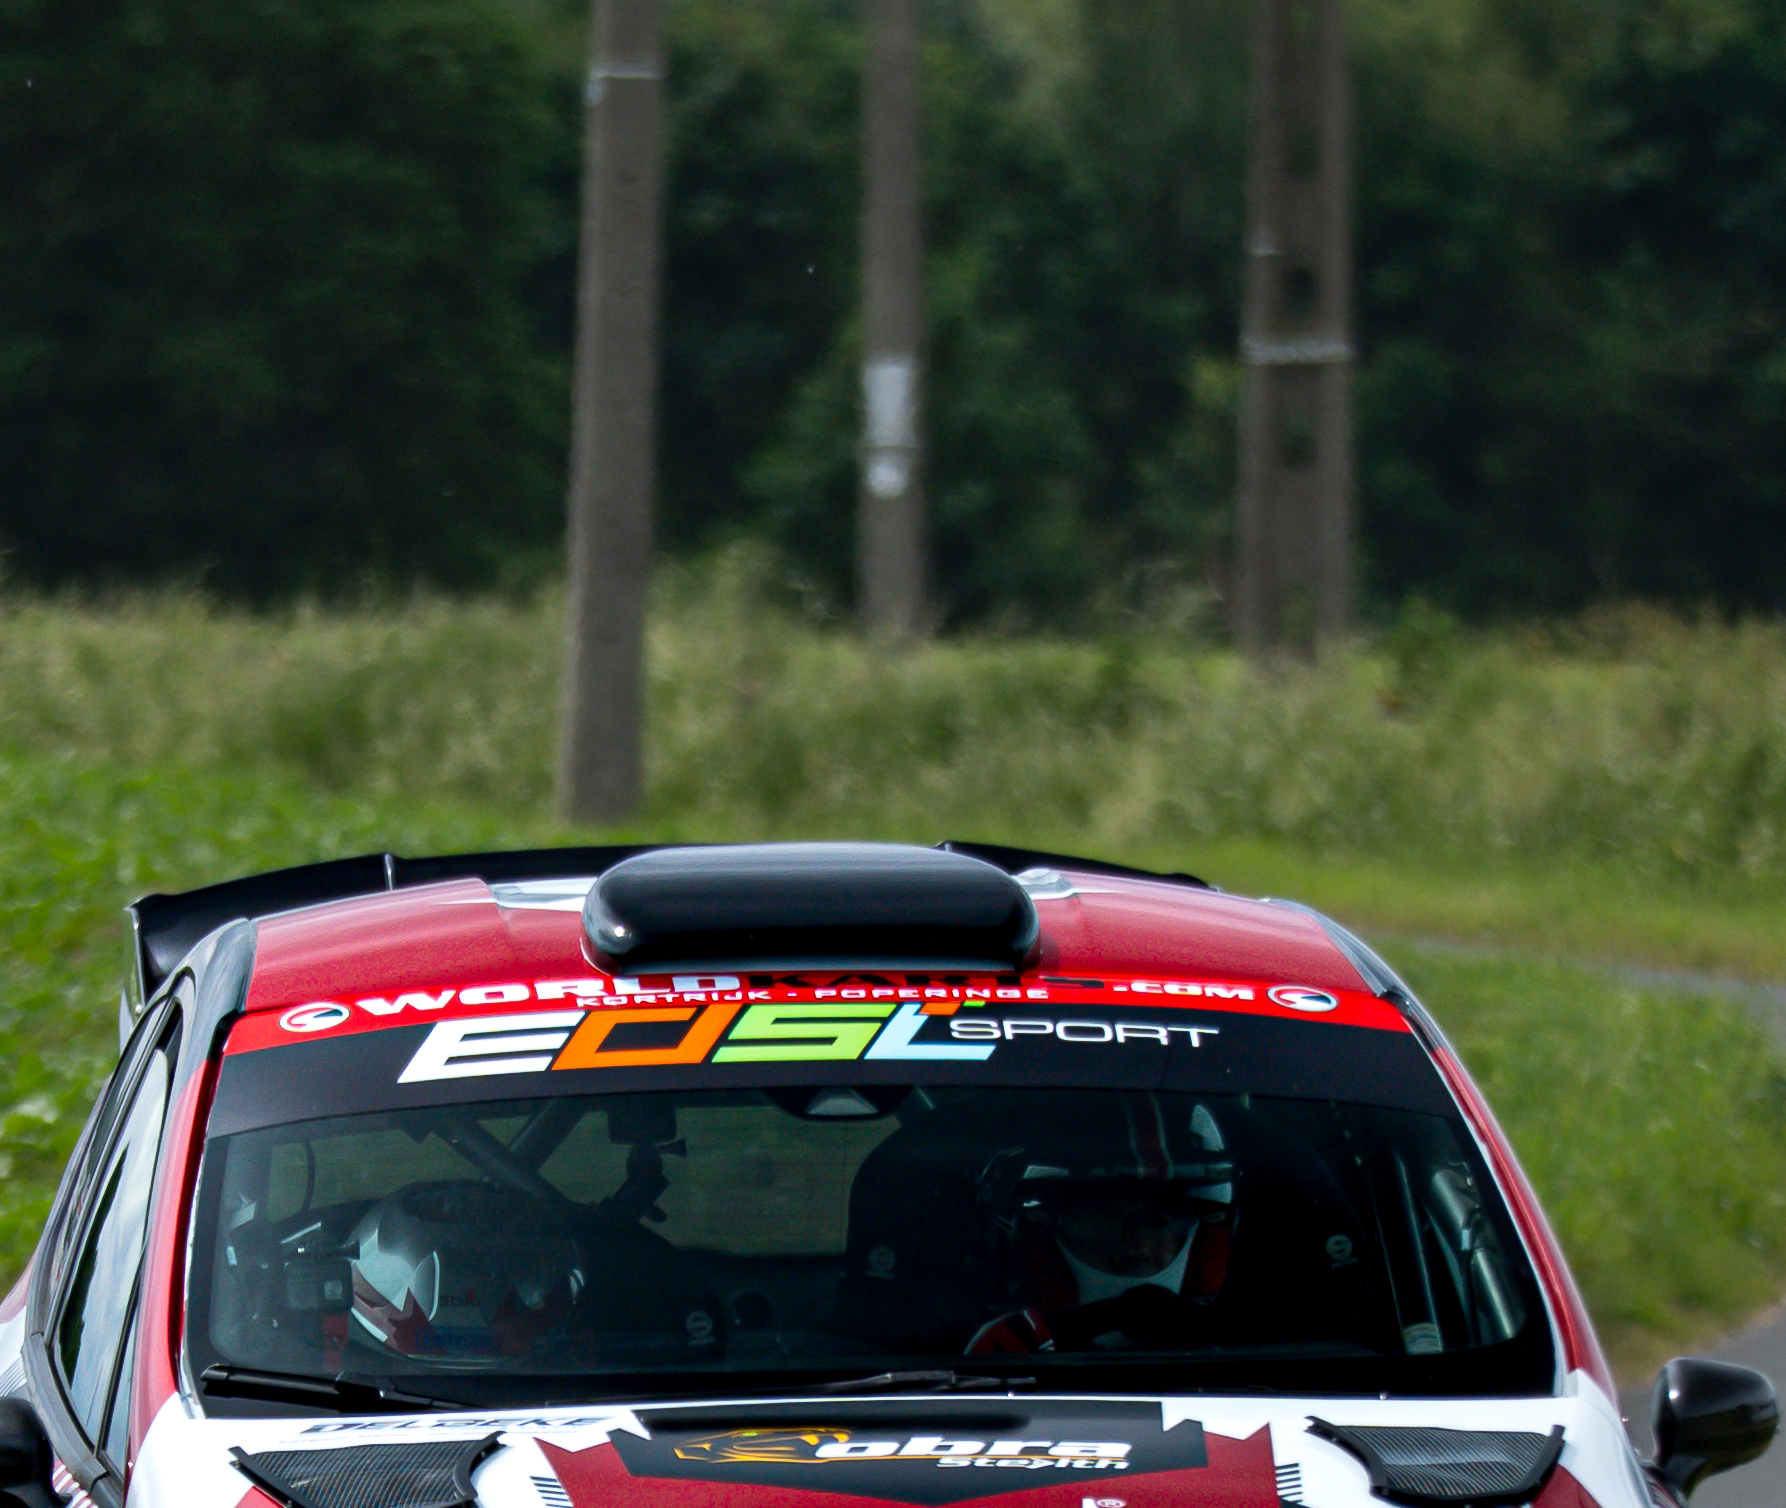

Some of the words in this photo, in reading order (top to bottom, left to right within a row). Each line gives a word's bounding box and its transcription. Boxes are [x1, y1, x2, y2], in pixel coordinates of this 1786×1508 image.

[575, 989, 773, 1007] KORTRIJK
[814, 986, 1050, 1000] POPERINGE
[949, 1018, 1219, 1048] SPORT
